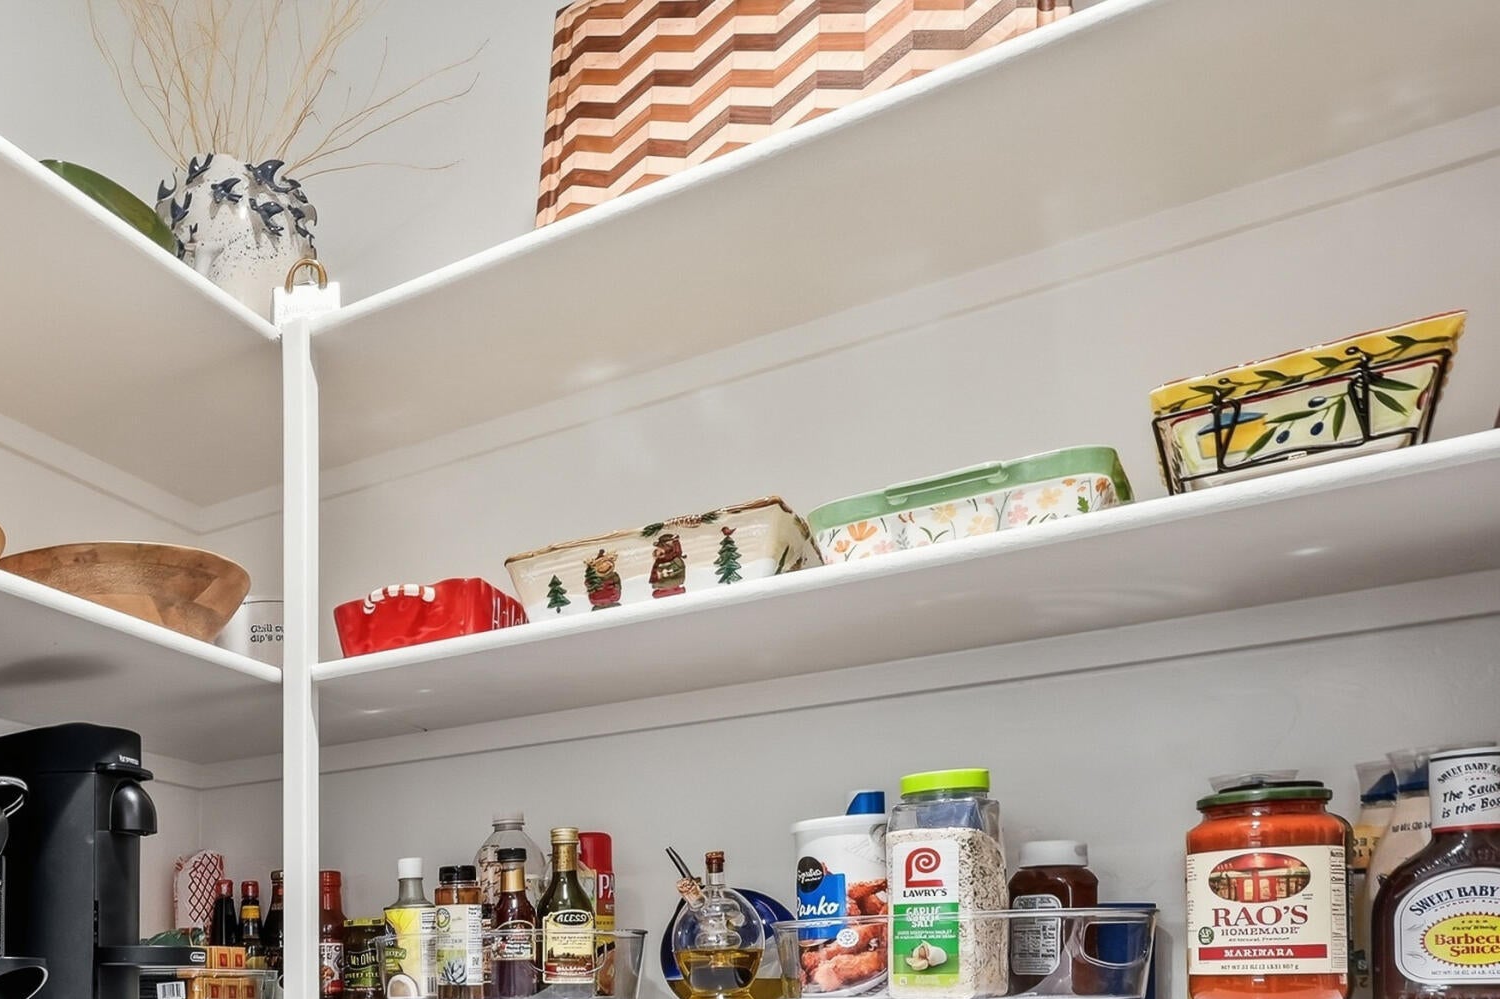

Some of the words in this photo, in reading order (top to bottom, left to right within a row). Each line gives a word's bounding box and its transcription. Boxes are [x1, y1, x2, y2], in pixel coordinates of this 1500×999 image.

[1441, 789, 1464, 804] The
[1441, 806, 1451, 820] is
[1454, 801, 1477, 816] the
[902, 887, 948, 899] LAWRY'S
[1408, 887, 1454, 917] SWEET
[1456, 884, 1500, 899] BABY
[1211, 903, 1309, 928] RAO'S
[1220, 926, 1301, 937] HOMEMADE
[1223, 947, 1295, 959] MARINARA
